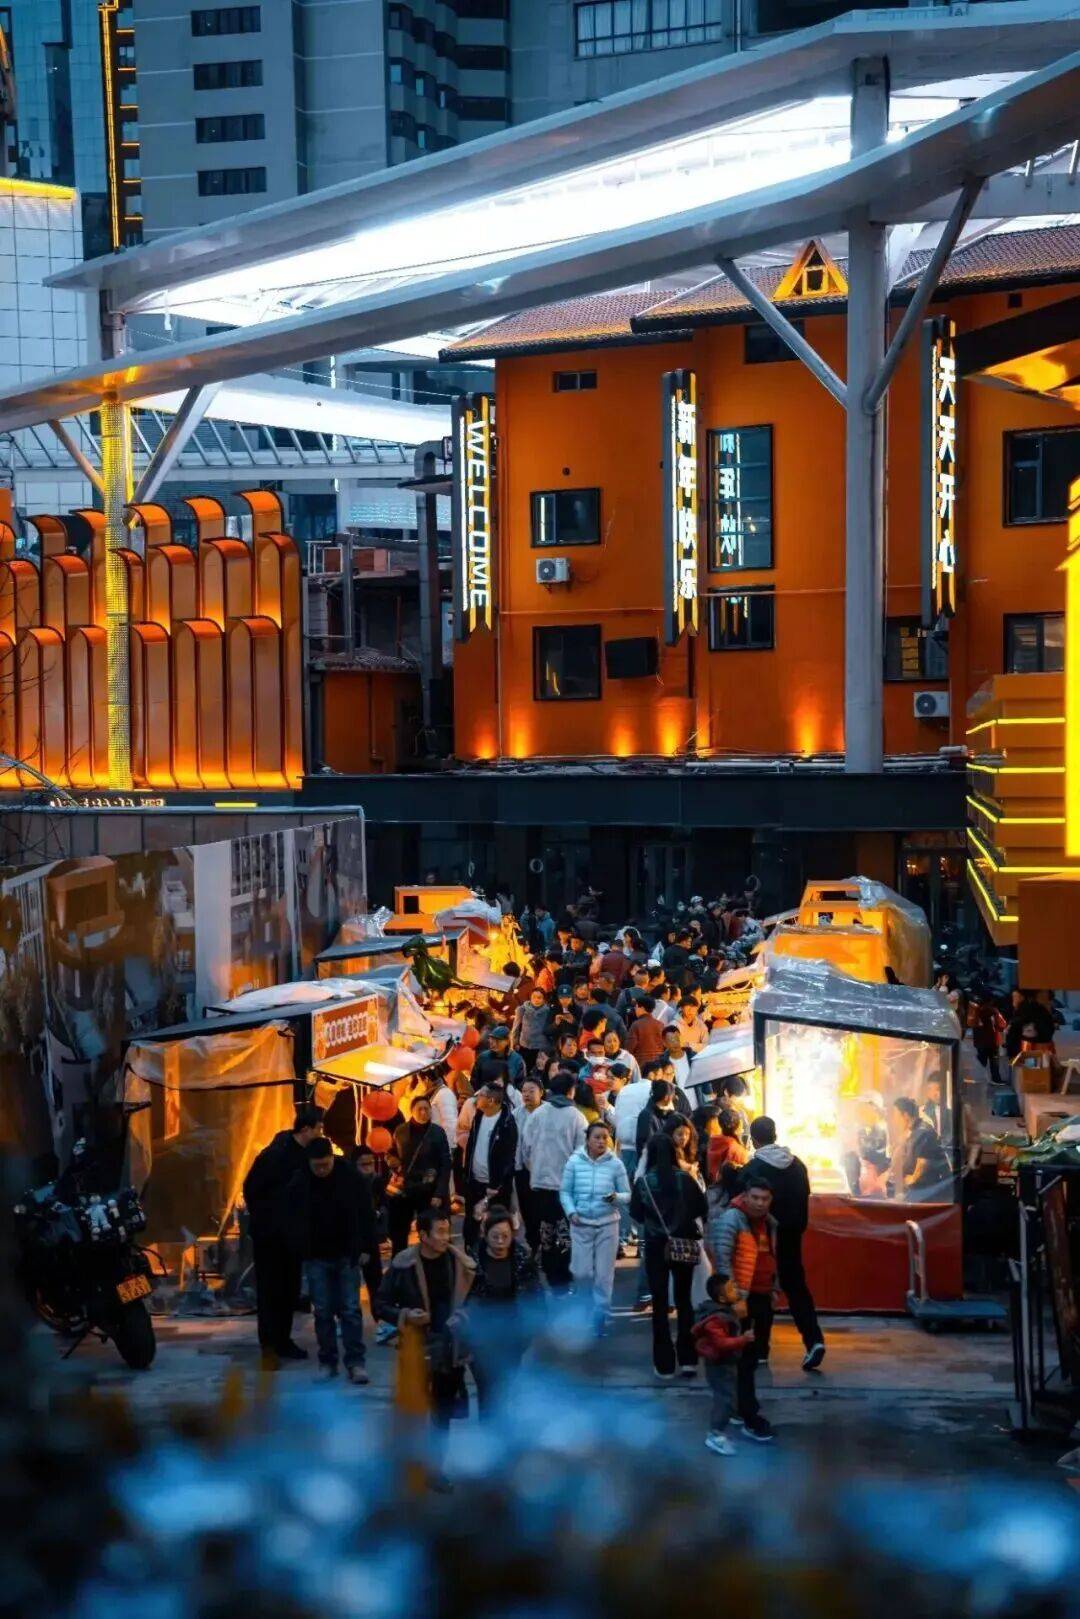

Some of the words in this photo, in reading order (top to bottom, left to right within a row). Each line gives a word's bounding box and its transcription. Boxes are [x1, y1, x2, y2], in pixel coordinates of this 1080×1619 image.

[467, 420, 490, 609] WELCOME
[678, 401, 696, 599] 新年快乐
[938, 356, 956, 573] 天天开心
